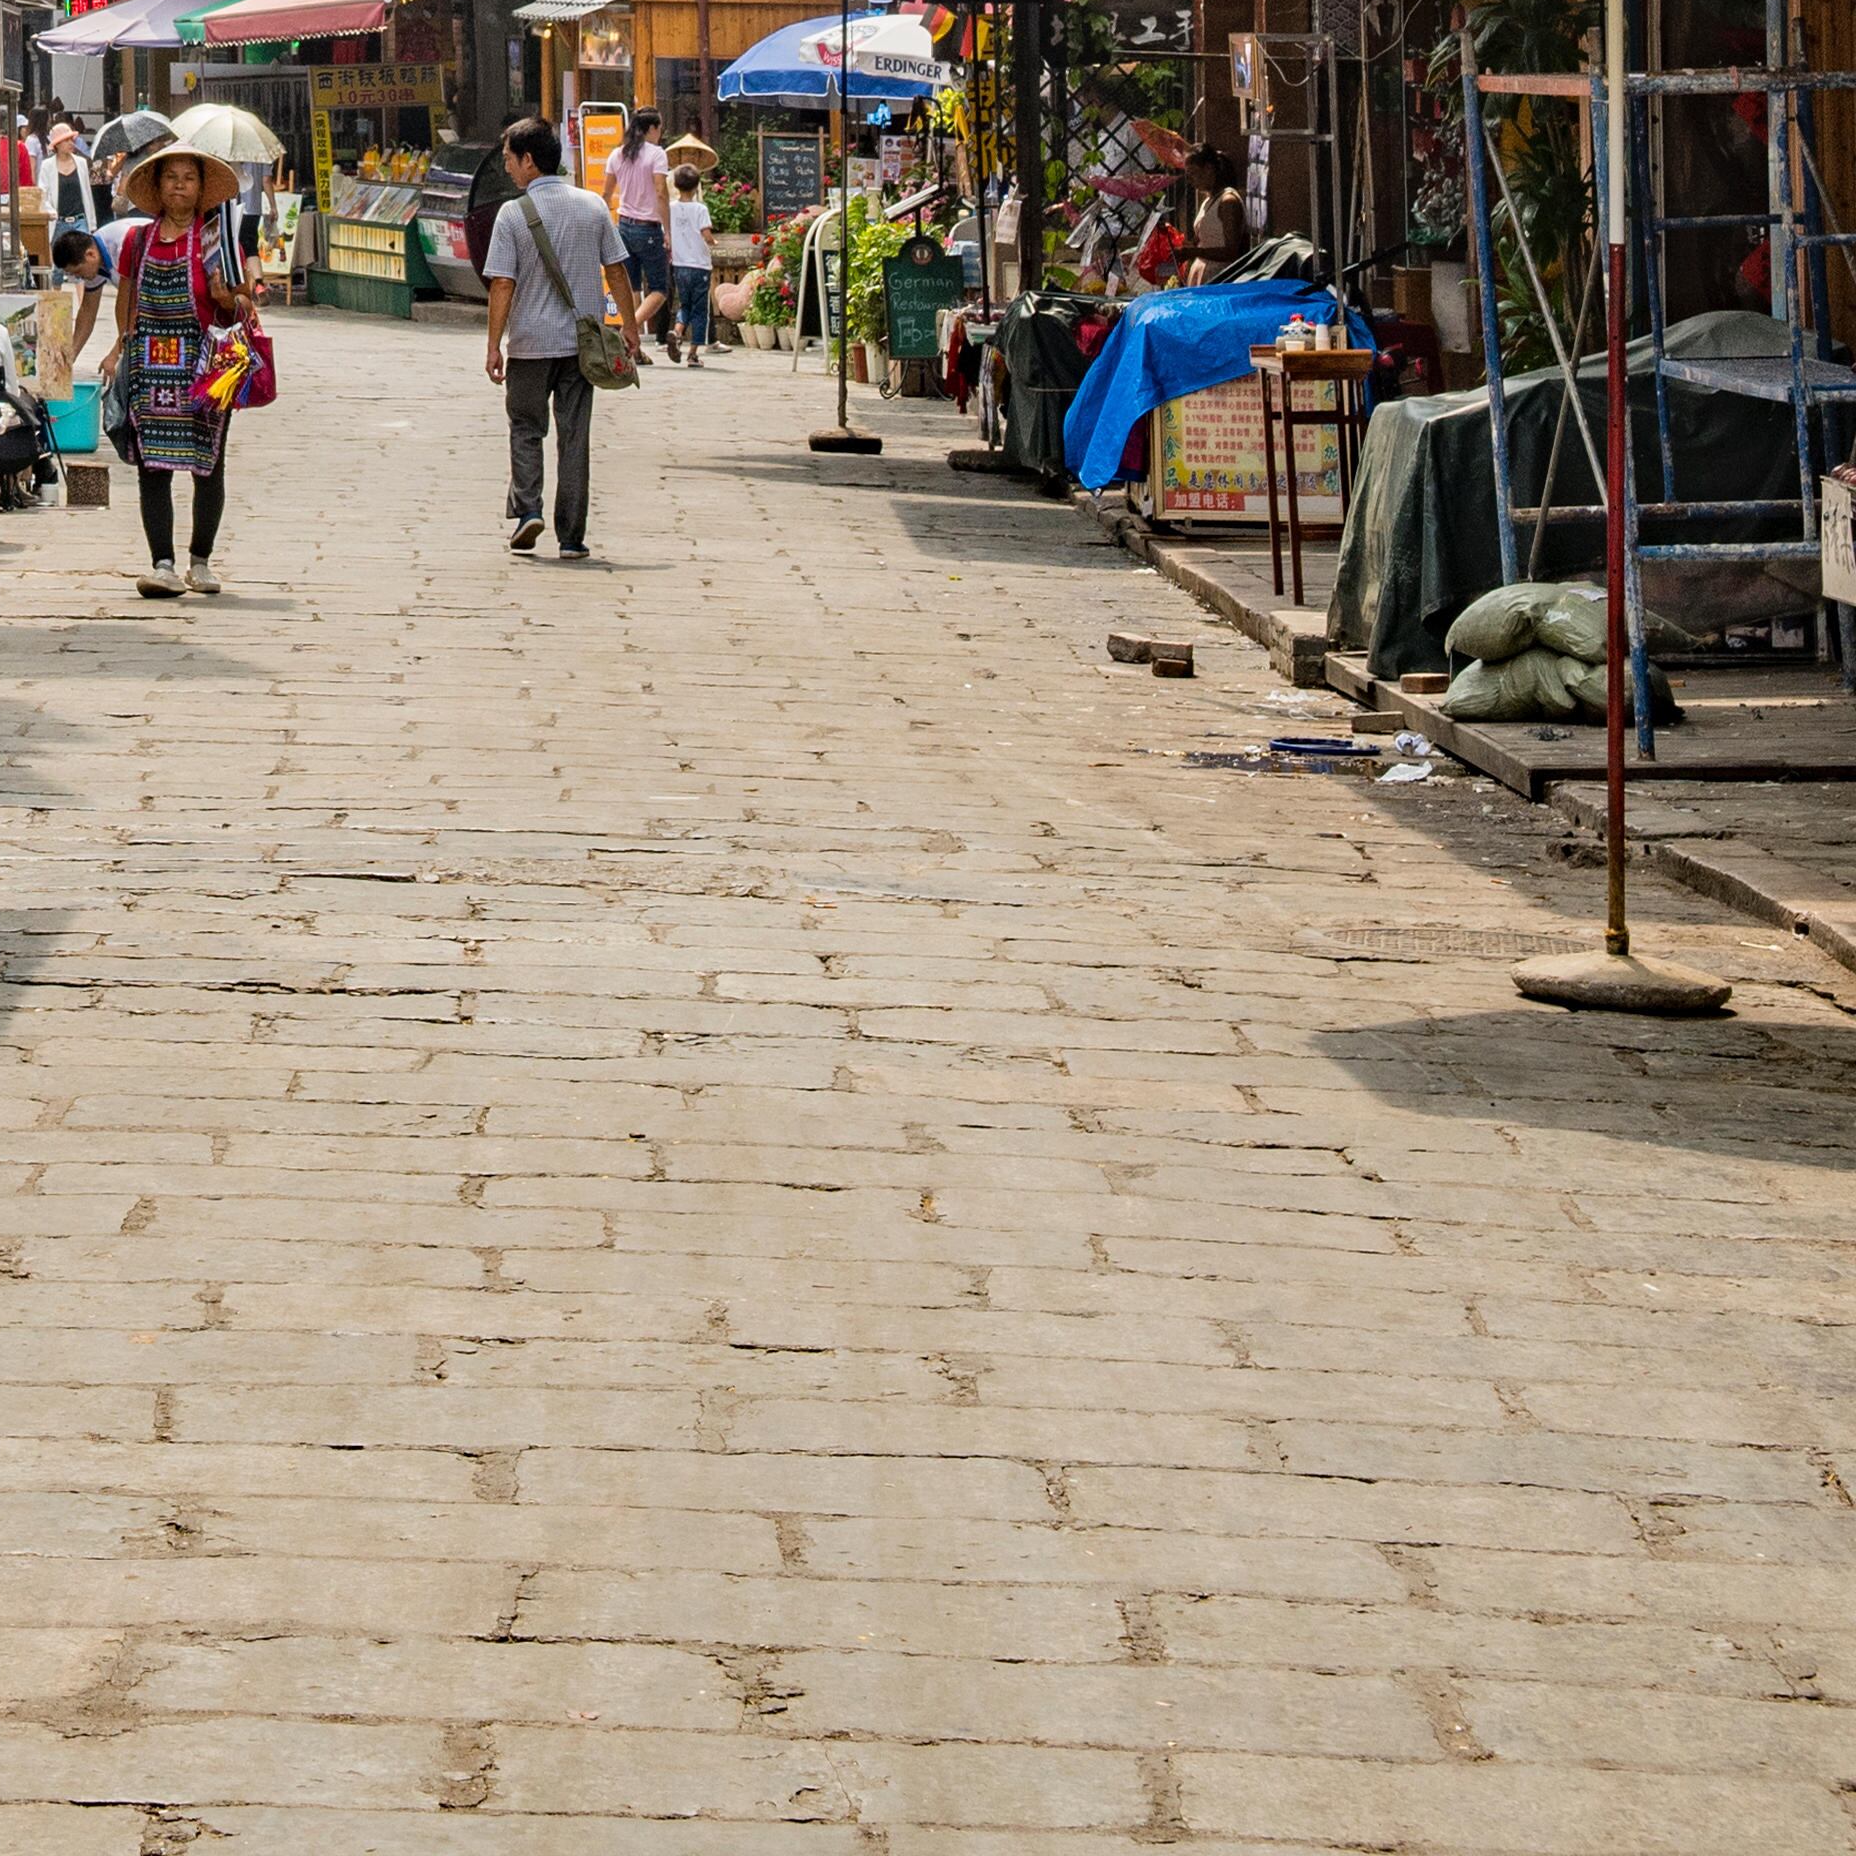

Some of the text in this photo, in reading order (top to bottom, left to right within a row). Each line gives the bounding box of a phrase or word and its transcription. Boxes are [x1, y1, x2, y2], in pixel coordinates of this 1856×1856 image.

[874, 55, 943, 80] ERDINGER
[337, 88, 416, 105] 10元30串
[888, 272, 955, 290] German
